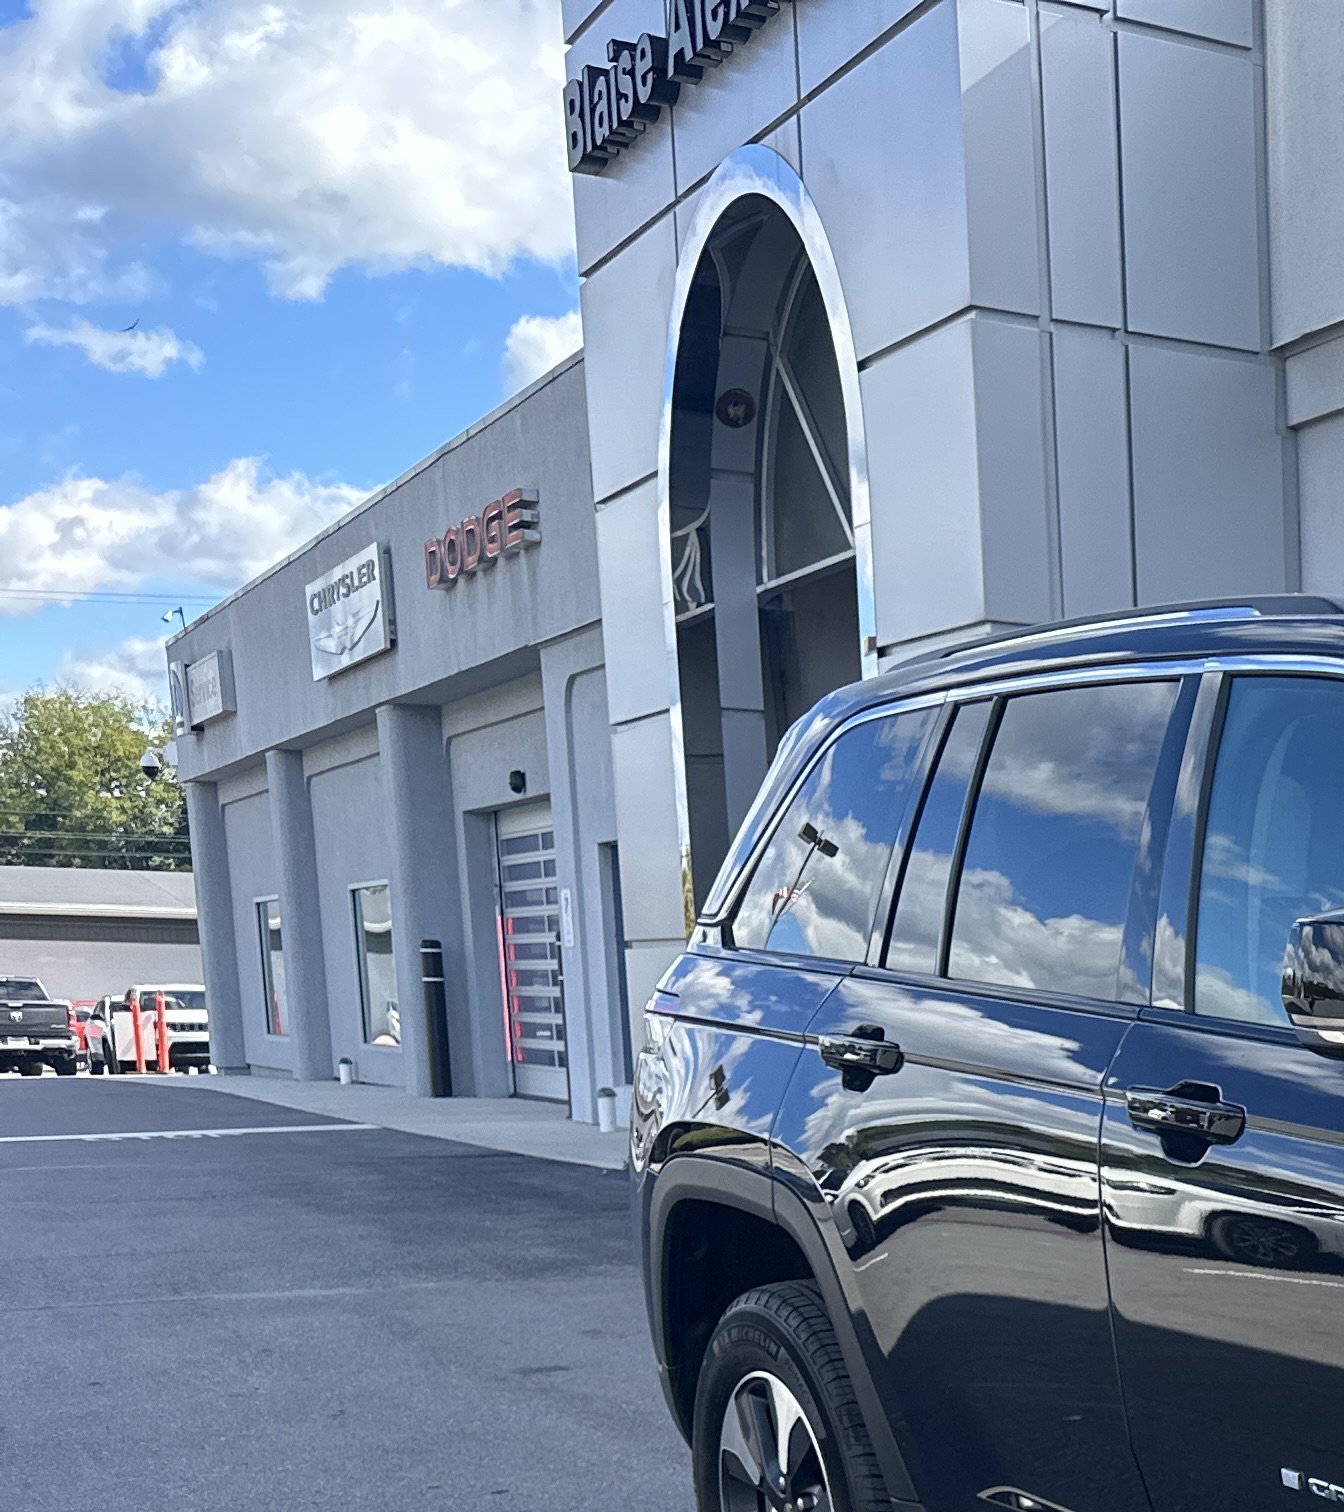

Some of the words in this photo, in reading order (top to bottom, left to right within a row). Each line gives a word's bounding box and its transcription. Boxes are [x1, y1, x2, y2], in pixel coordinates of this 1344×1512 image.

[563, 33, 656, 172] Blaise
[309, 559, 376, 616] CHRYSLER
[424, 488, 537, 589] DODGE
